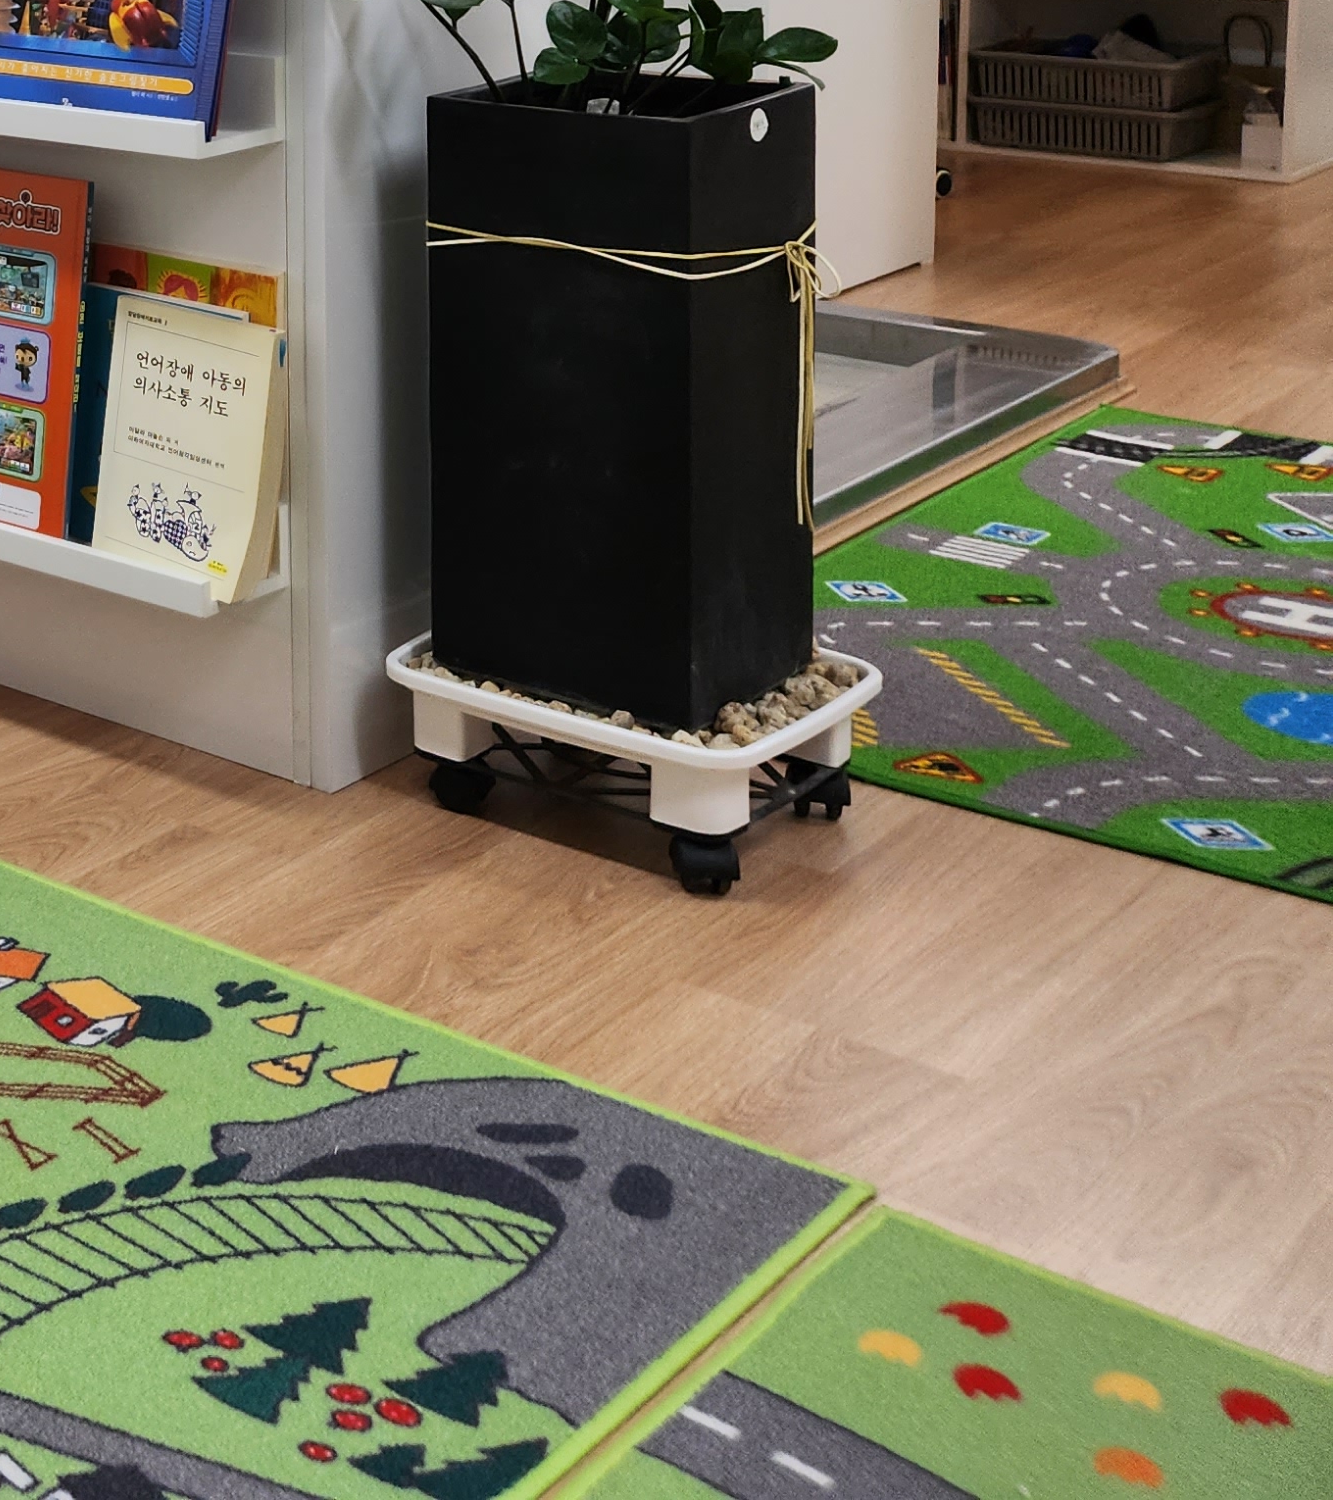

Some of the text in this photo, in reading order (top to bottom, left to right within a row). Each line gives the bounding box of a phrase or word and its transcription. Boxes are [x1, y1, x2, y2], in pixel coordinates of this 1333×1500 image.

[136, 350, 247, 397] 언어장애 아동의
[133, 377, 229, 417] 의사소통 지도
